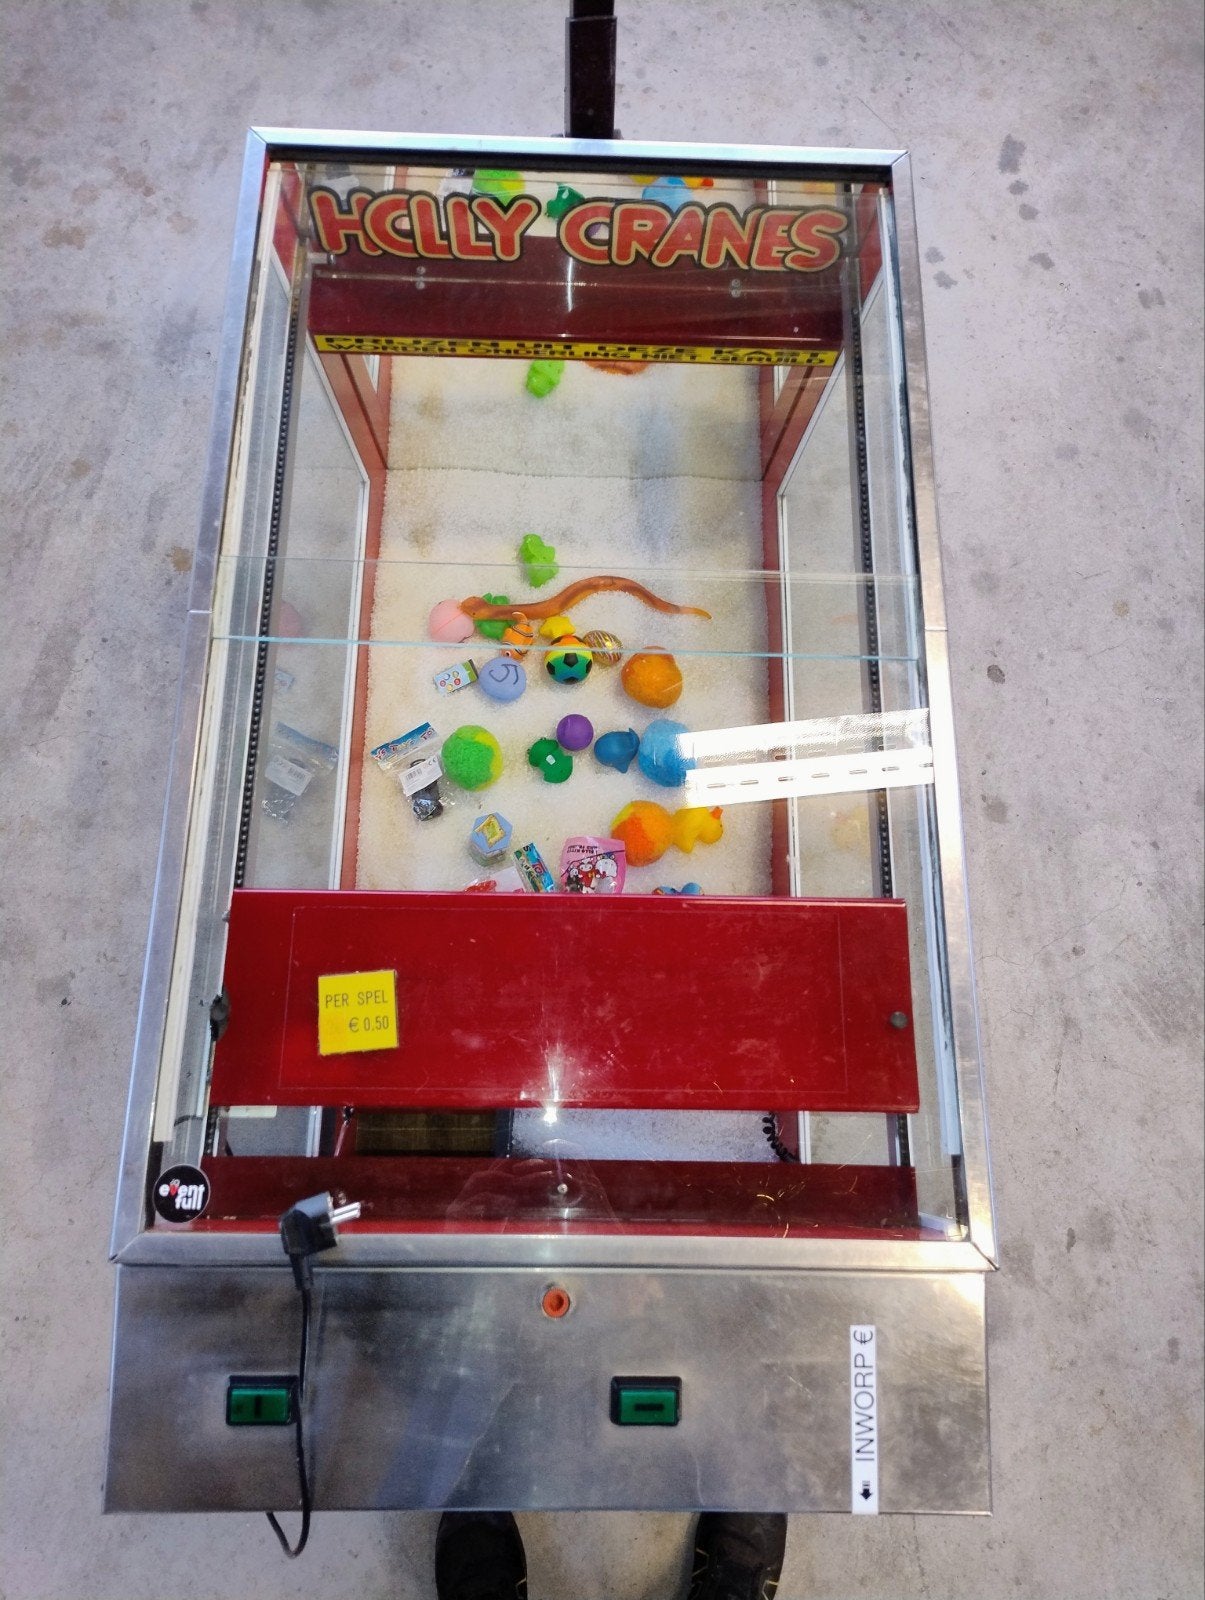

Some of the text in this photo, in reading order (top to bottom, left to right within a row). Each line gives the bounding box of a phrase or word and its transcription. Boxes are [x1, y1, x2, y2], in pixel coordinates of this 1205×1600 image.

[557, 197, 848, 273] CRANES
[325, 990, 388, 1008] PER SPEL
[854, 1352, 875, 1462] INWORP
